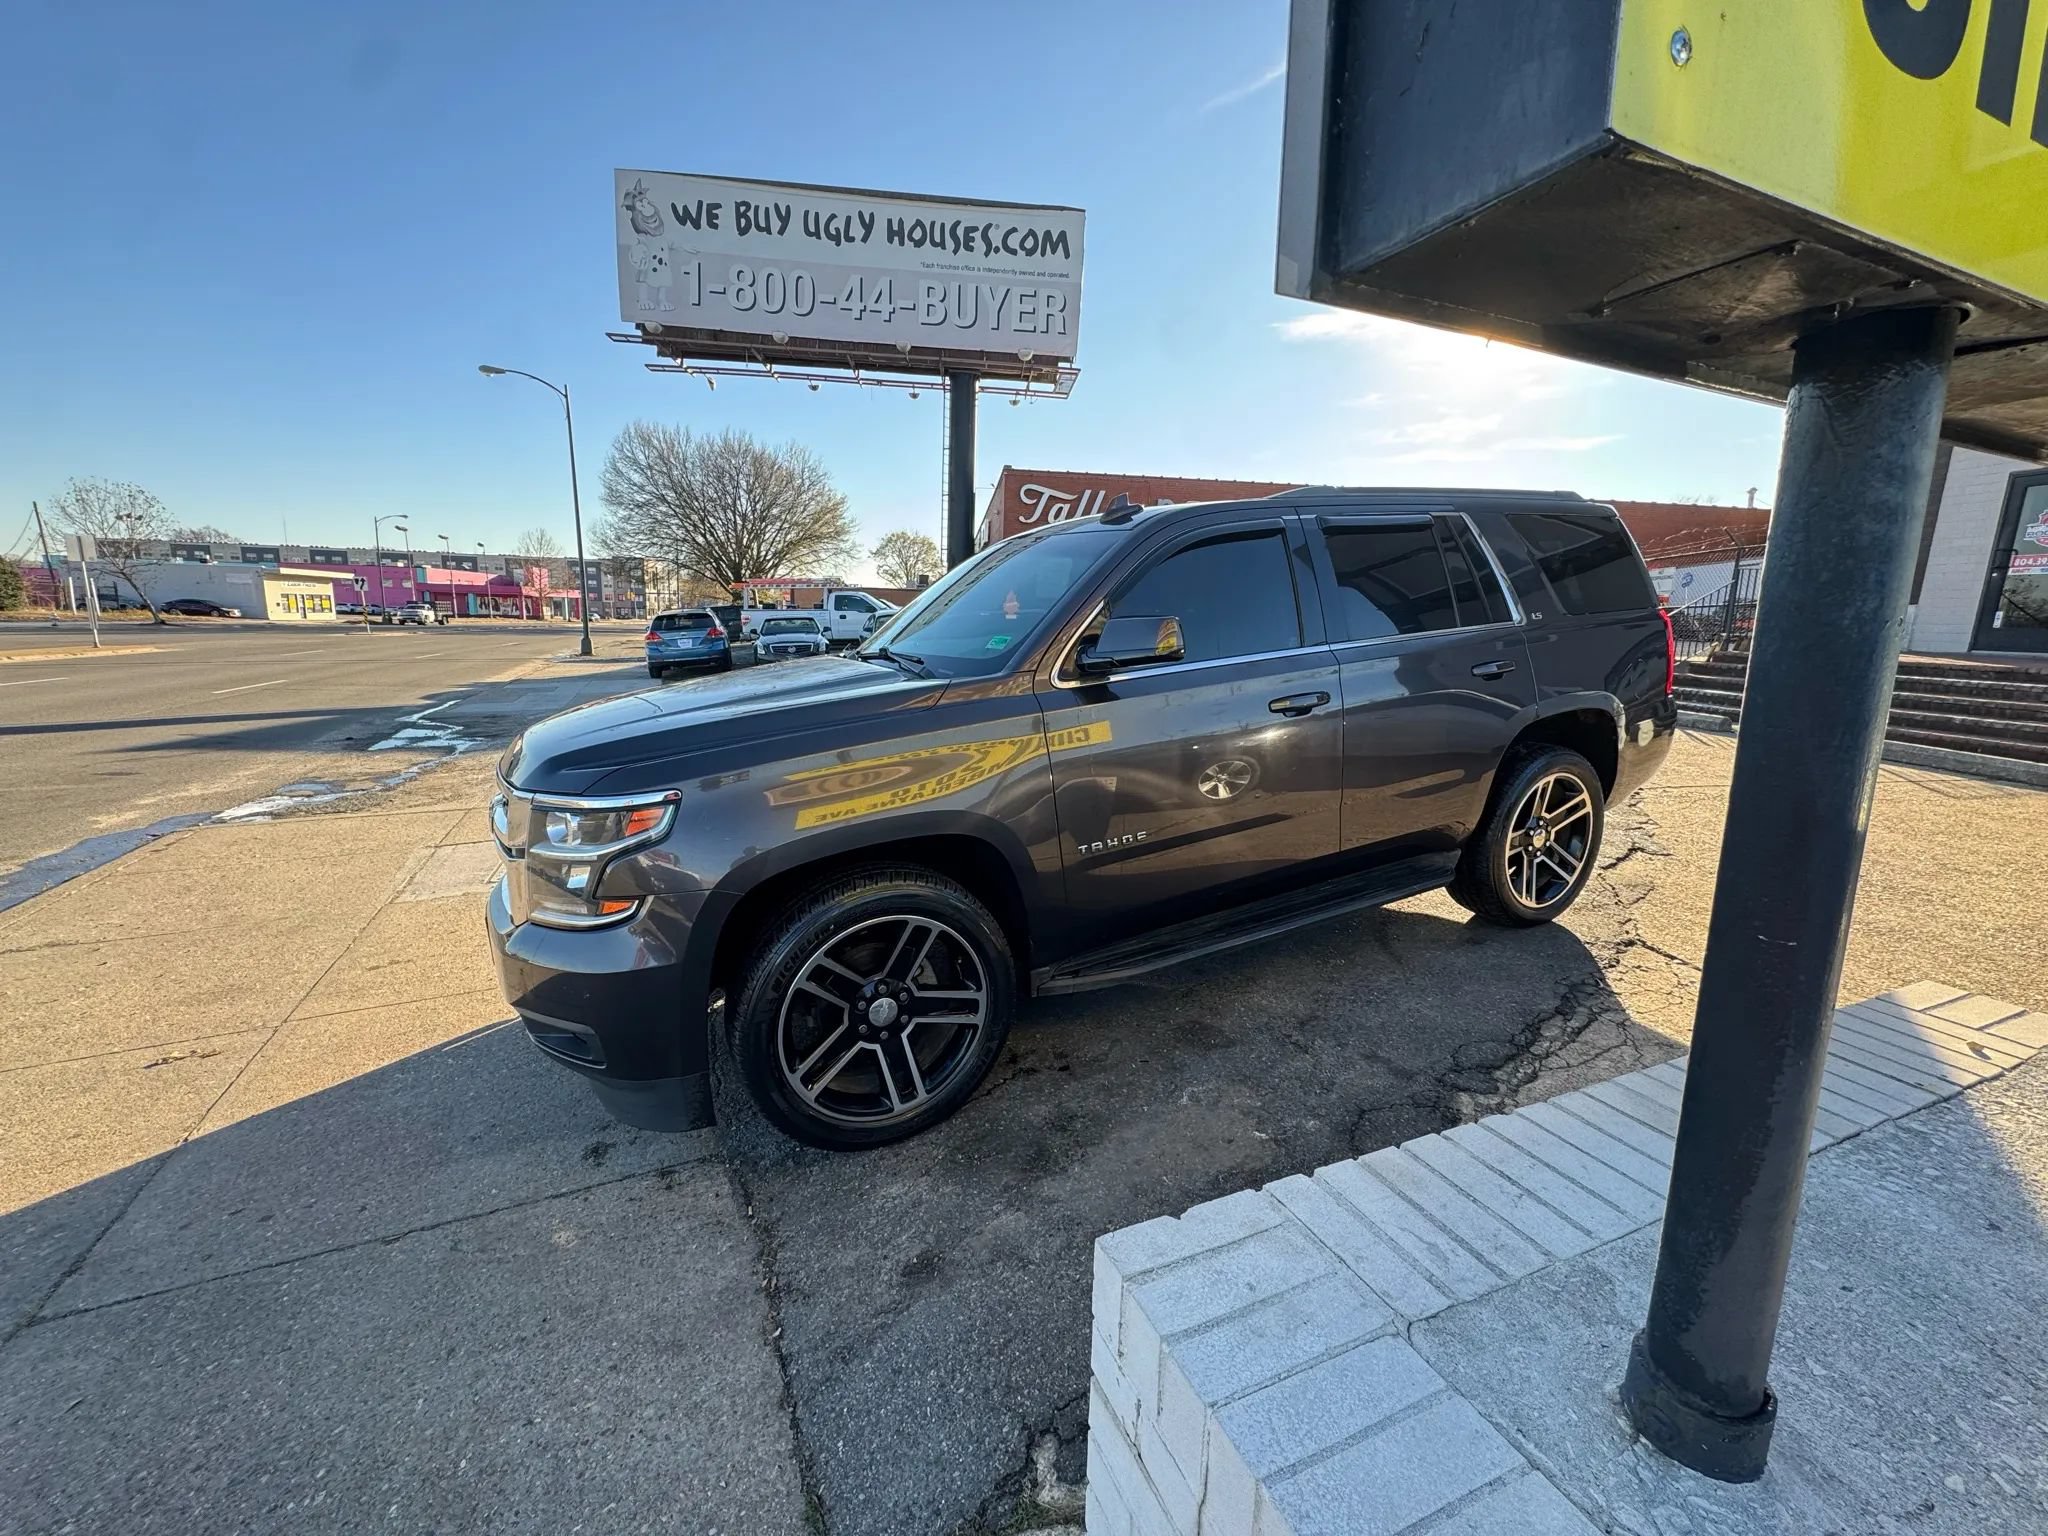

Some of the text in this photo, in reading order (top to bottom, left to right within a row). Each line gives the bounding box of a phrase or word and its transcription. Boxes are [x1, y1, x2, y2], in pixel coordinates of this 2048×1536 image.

[671, 200, 723, 231] WE
[735, 200, 791, 237] BUY
[803, 208, 875, 247] UGLY
[982, 266, 1017, 276] independently
[681, 260, 1067, 335] 1-800-44-BUYER
[1077, 830, 1147, 855] TAHOE
